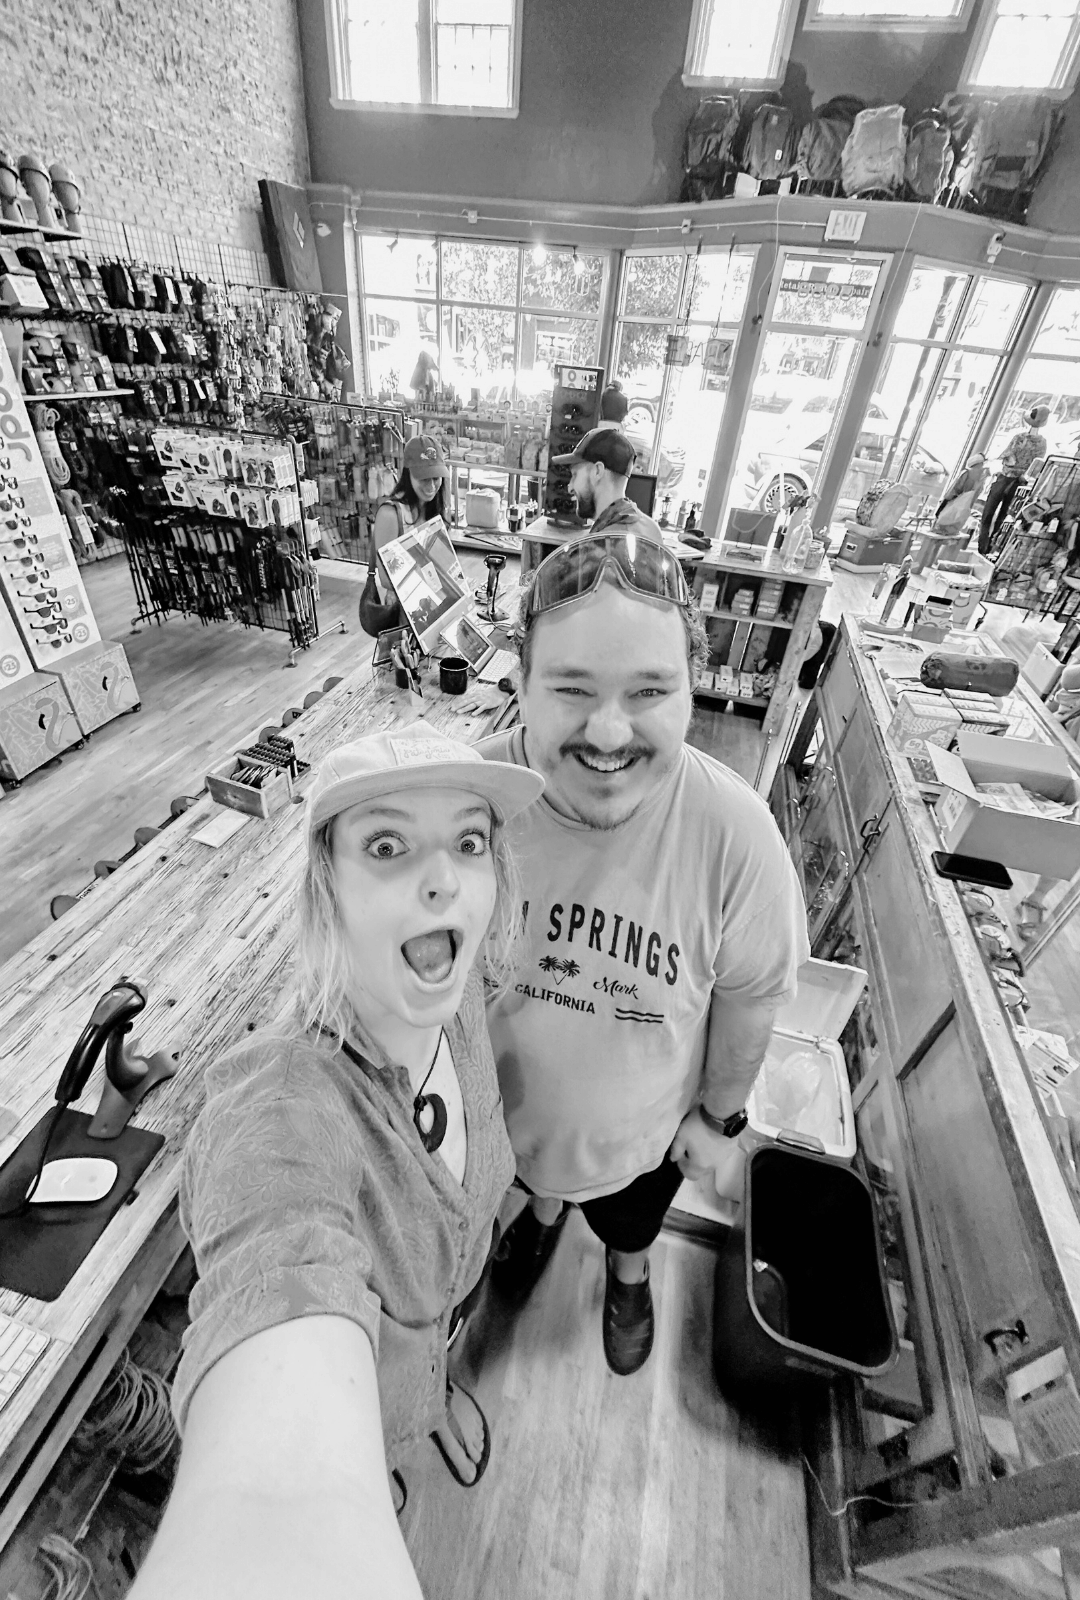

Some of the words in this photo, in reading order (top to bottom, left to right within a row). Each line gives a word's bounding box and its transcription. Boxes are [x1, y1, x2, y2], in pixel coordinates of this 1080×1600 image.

[832, 212, 862, 237] EXIT
[546, 903, 681, 986] SPRINGS
[514, 983, 596, 1014] CALIFORNIA
